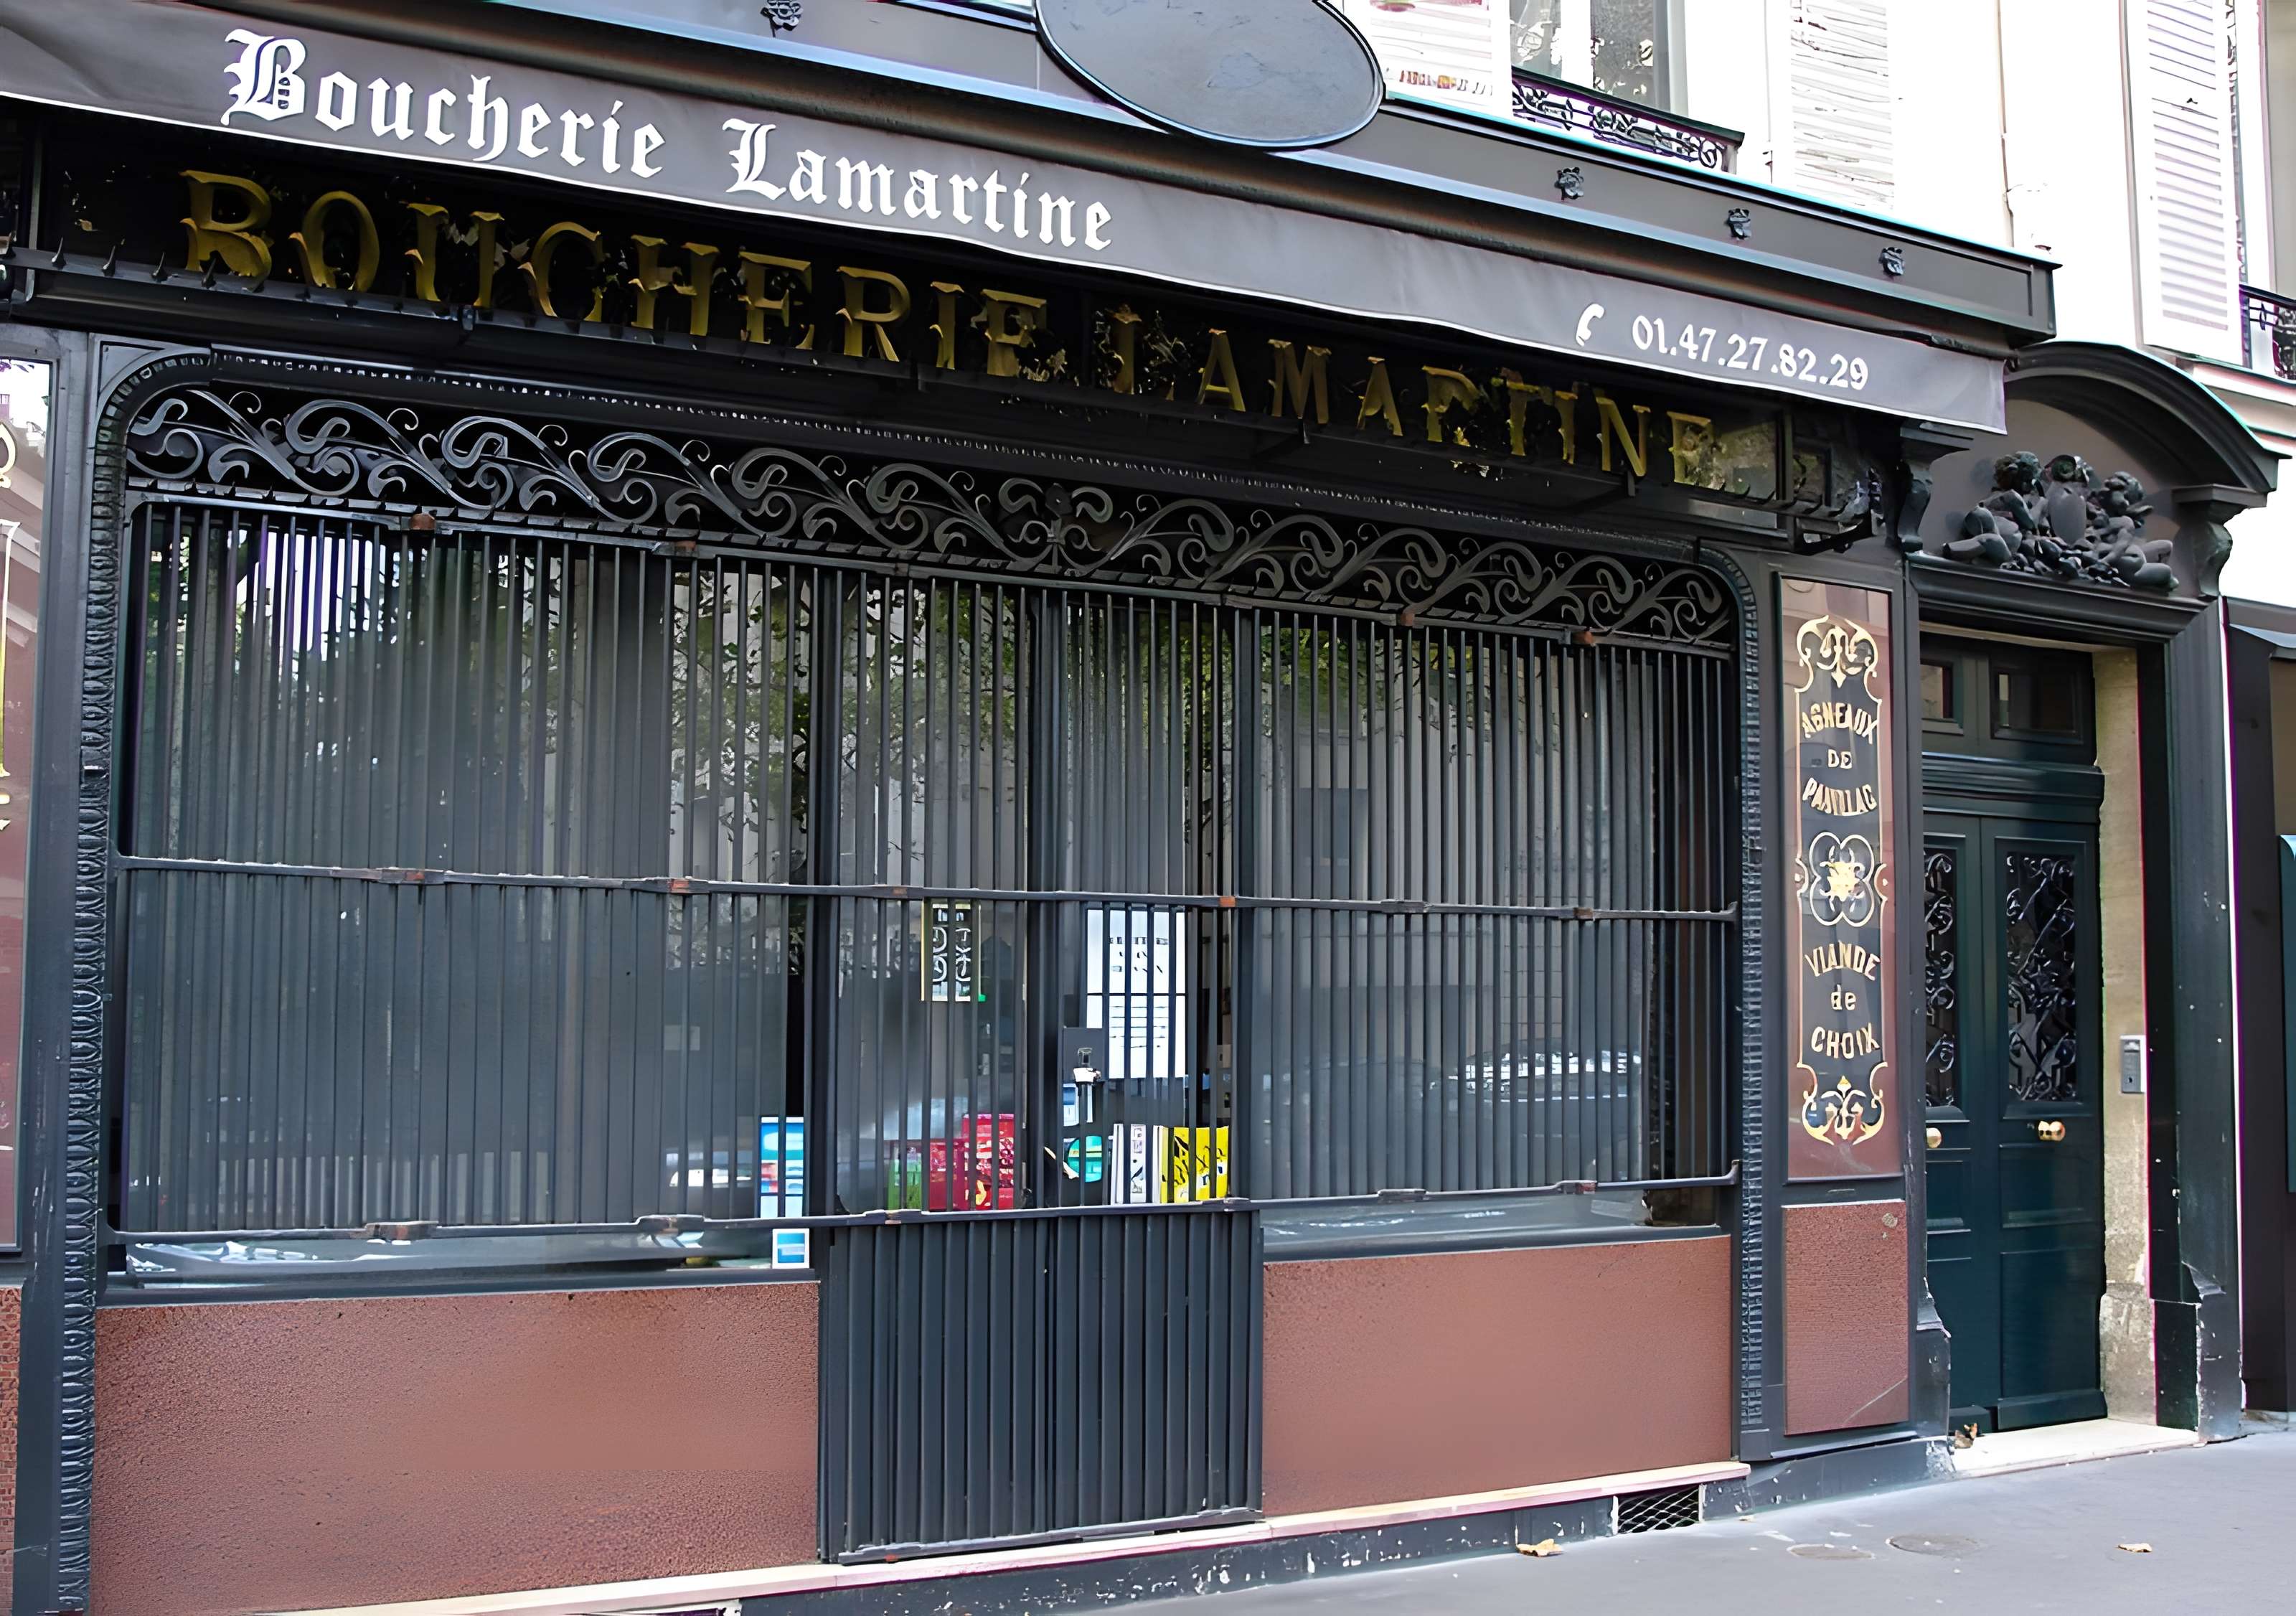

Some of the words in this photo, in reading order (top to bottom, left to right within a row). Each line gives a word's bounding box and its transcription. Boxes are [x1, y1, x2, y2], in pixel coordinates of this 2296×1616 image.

[220, 29, 666, 179] Boucherie
[721, 118, 1114, 252] Lamartine
[1632, 314, 1868, 391] 01.47.27.82.29
[1804, 939, 1881, 981] VIANDE
[1830, 984, 1857, 1010] de
[1811, 1022, 1881, 1059] CHOIX
